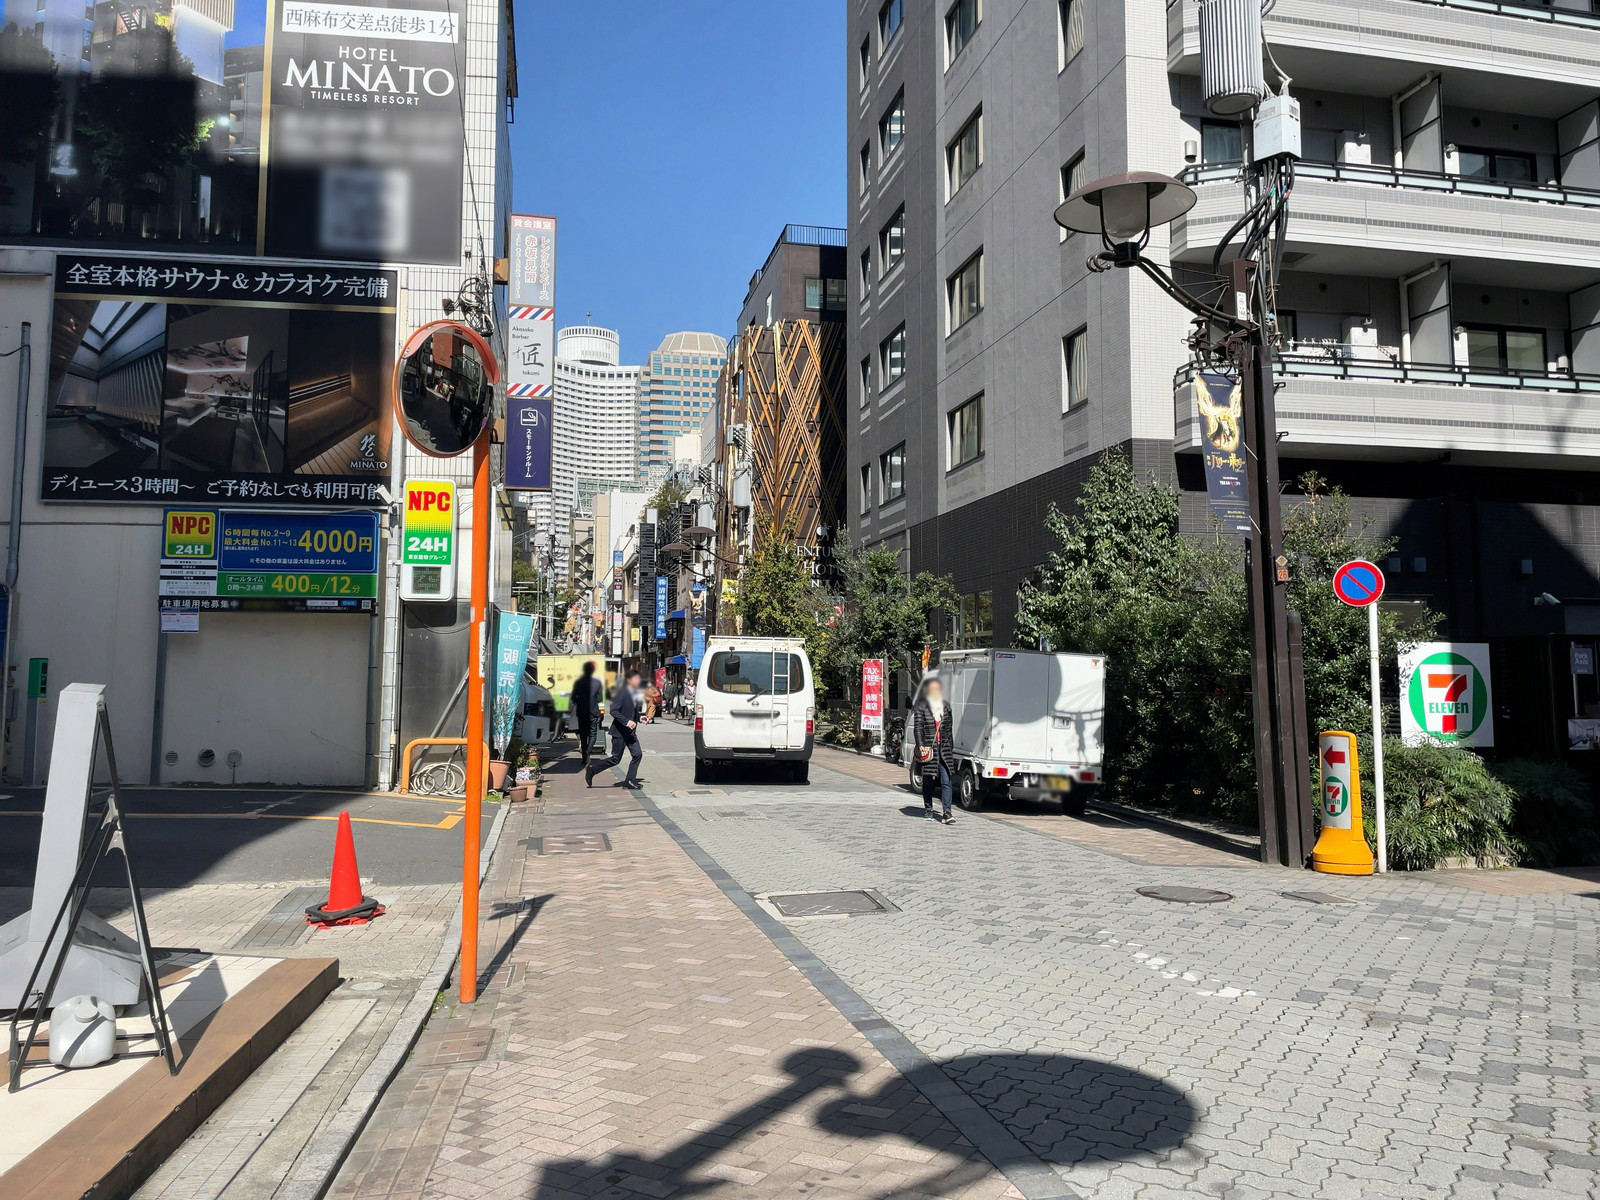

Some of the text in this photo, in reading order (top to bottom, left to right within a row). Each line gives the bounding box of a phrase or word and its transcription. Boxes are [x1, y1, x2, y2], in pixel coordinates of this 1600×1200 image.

[286, 8, 456, 37] 西麻布交差点徒歩1分
[338, 45, 398, 62] HOTEL
[282, 57, 455, 97] MINATO
[311, 90, 420, 106] TIMELESS RESORT
[522, 342, 545, 368] 匠
[350, 461, 388, 469] MINATO
[408, 490, 451, 512] NPC
[171, 515, 211, 535] NPC
[175, 544, 205, 555] 24H
[298, 529, 373, 553] 4000円
[407, 537, 448, 552] 24H
[1278, 570, 1288, 580] 26
[162, 599, 240, 609] 駐車場用地募集中
[864, 674, 880, 682] FREE
[1427, 673, 1468, 733] 7
